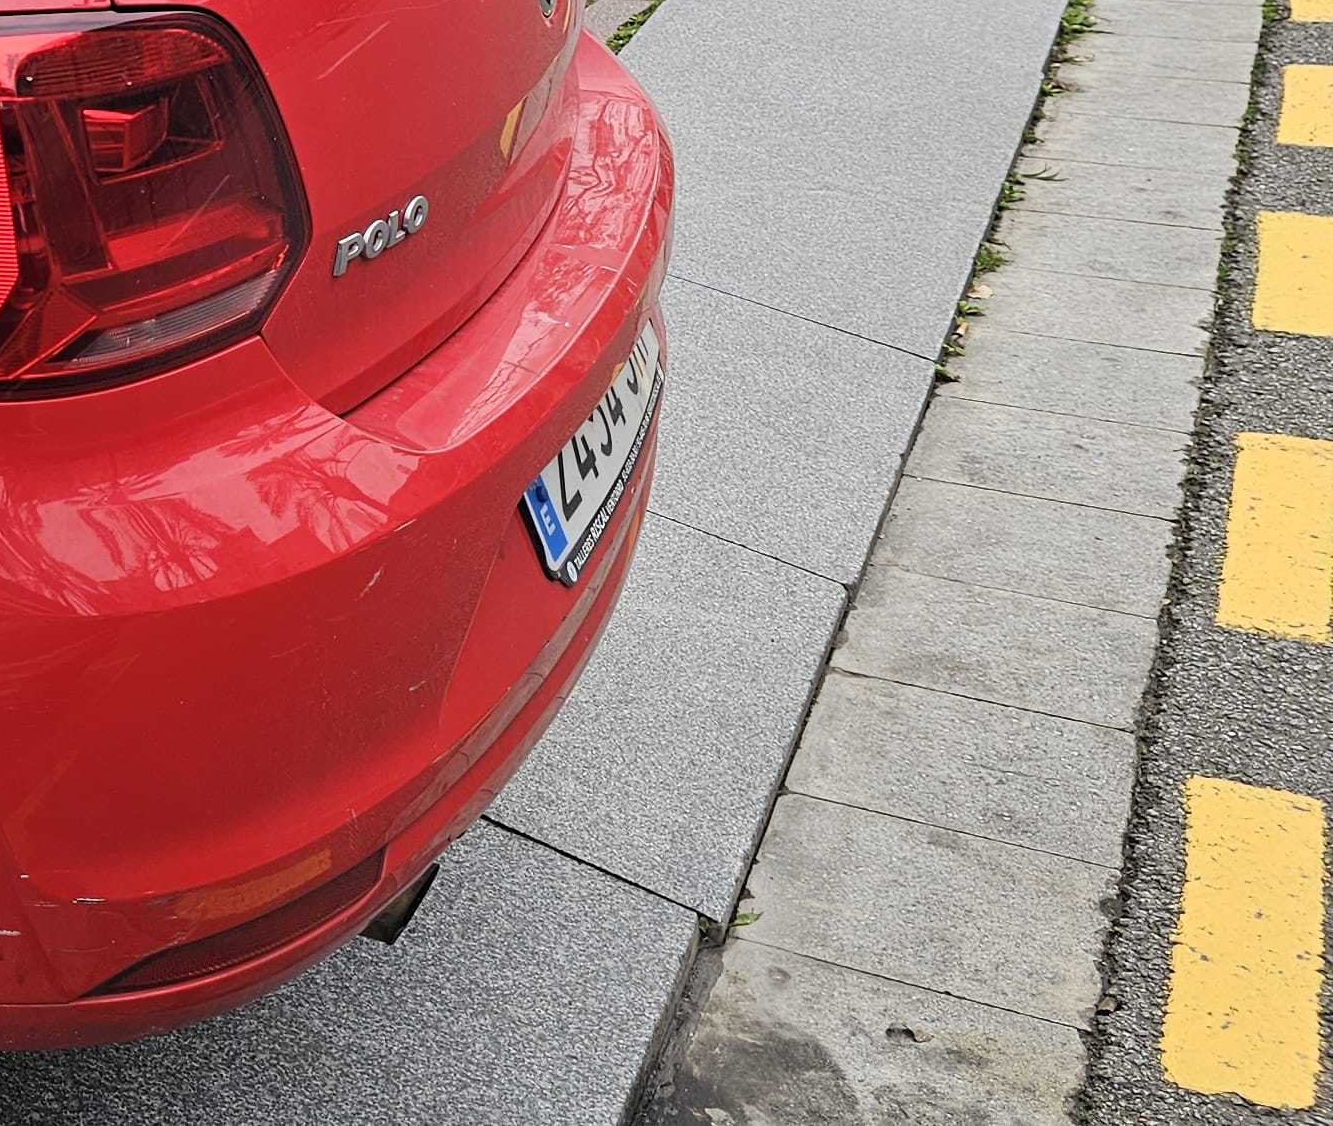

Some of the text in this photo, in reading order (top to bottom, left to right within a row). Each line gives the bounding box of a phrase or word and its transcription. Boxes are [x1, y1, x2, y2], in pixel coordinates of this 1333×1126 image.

[332, 194, 430, 277] POLO
[539, 503, 556, 537] E
[573, 534, 596, 571] TALLERES
[589, 507, 610, 542] RISCAL
